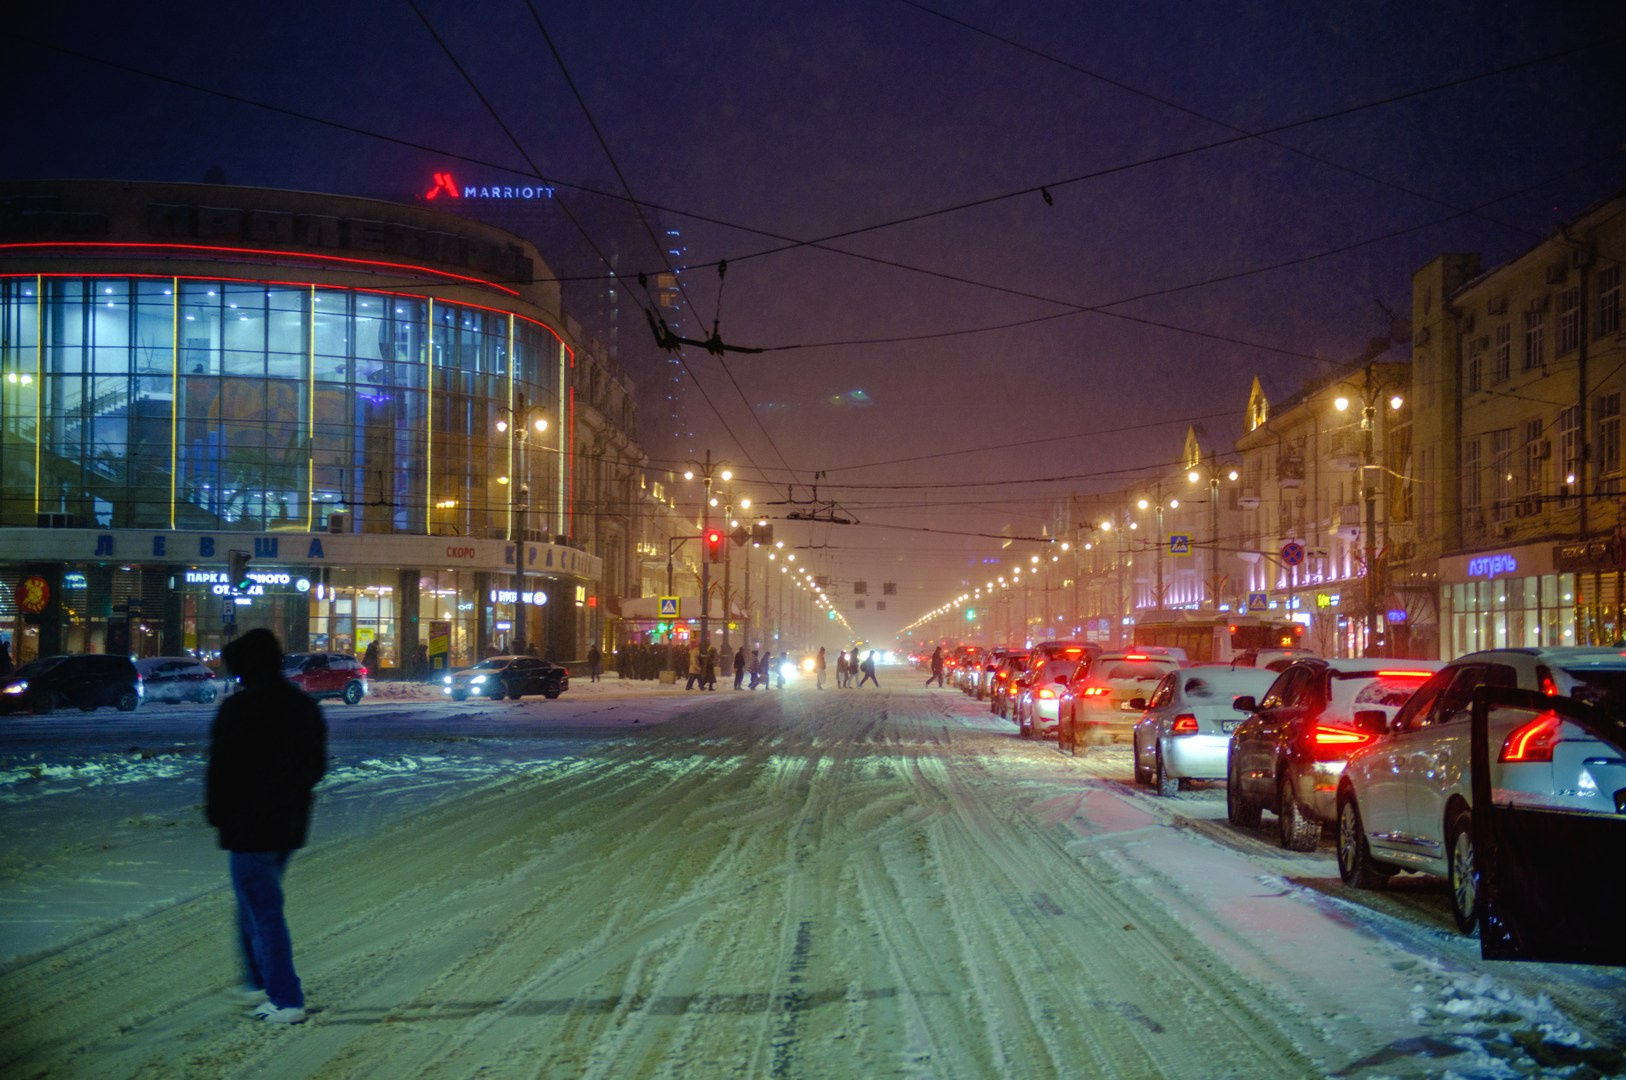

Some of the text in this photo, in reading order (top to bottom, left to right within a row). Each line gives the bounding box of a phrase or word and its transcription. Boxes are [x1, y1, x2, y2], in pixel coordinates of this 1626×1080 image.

[464, 186, 554, 198] MARRIOTT
[94, 535, 324, 559] ЛЕВША
[446, 546, 475, 559] СКОРО
[186, 573, 218, 583] ПАРК
[213, 585, 264, 595] ОТХА
